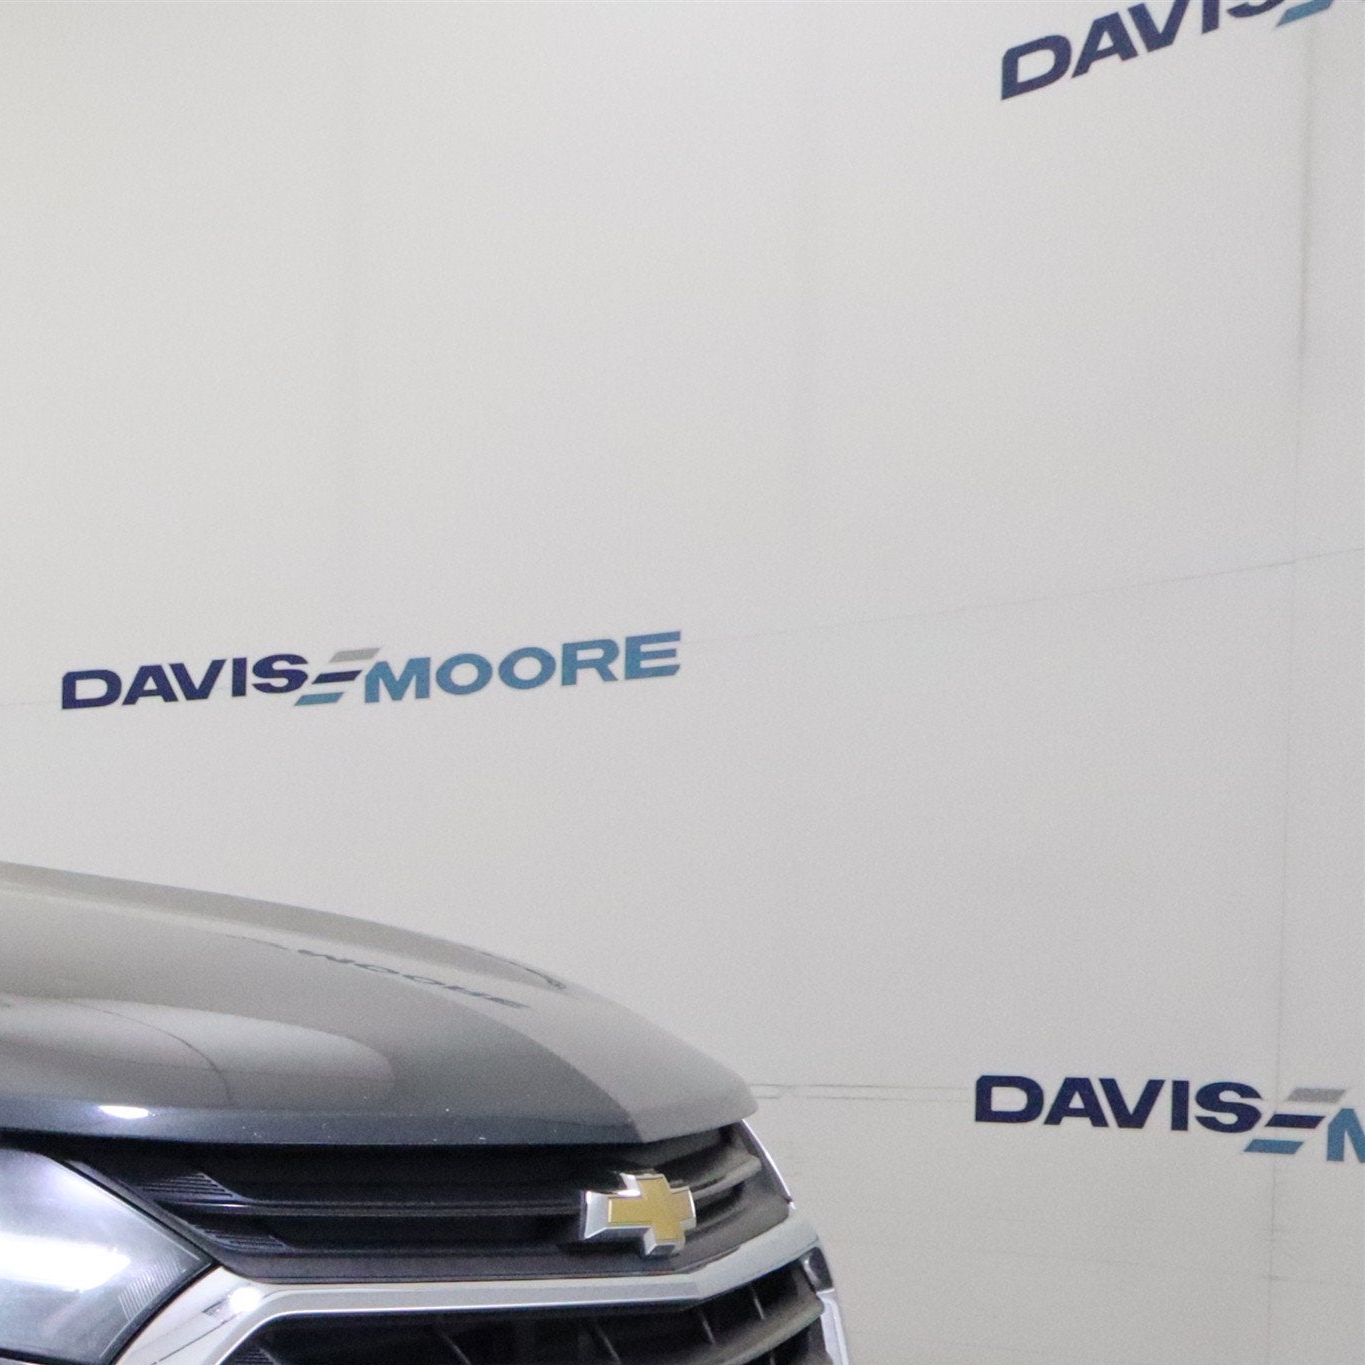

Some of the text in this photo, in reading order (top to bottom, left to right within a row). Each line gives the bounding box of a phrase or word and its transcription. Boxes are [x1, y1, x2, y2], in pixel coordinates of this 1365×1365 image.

[61, 630, 682, 710] DAVIS MOORE
[975, 1074, 1263, 1134] DAVIS
